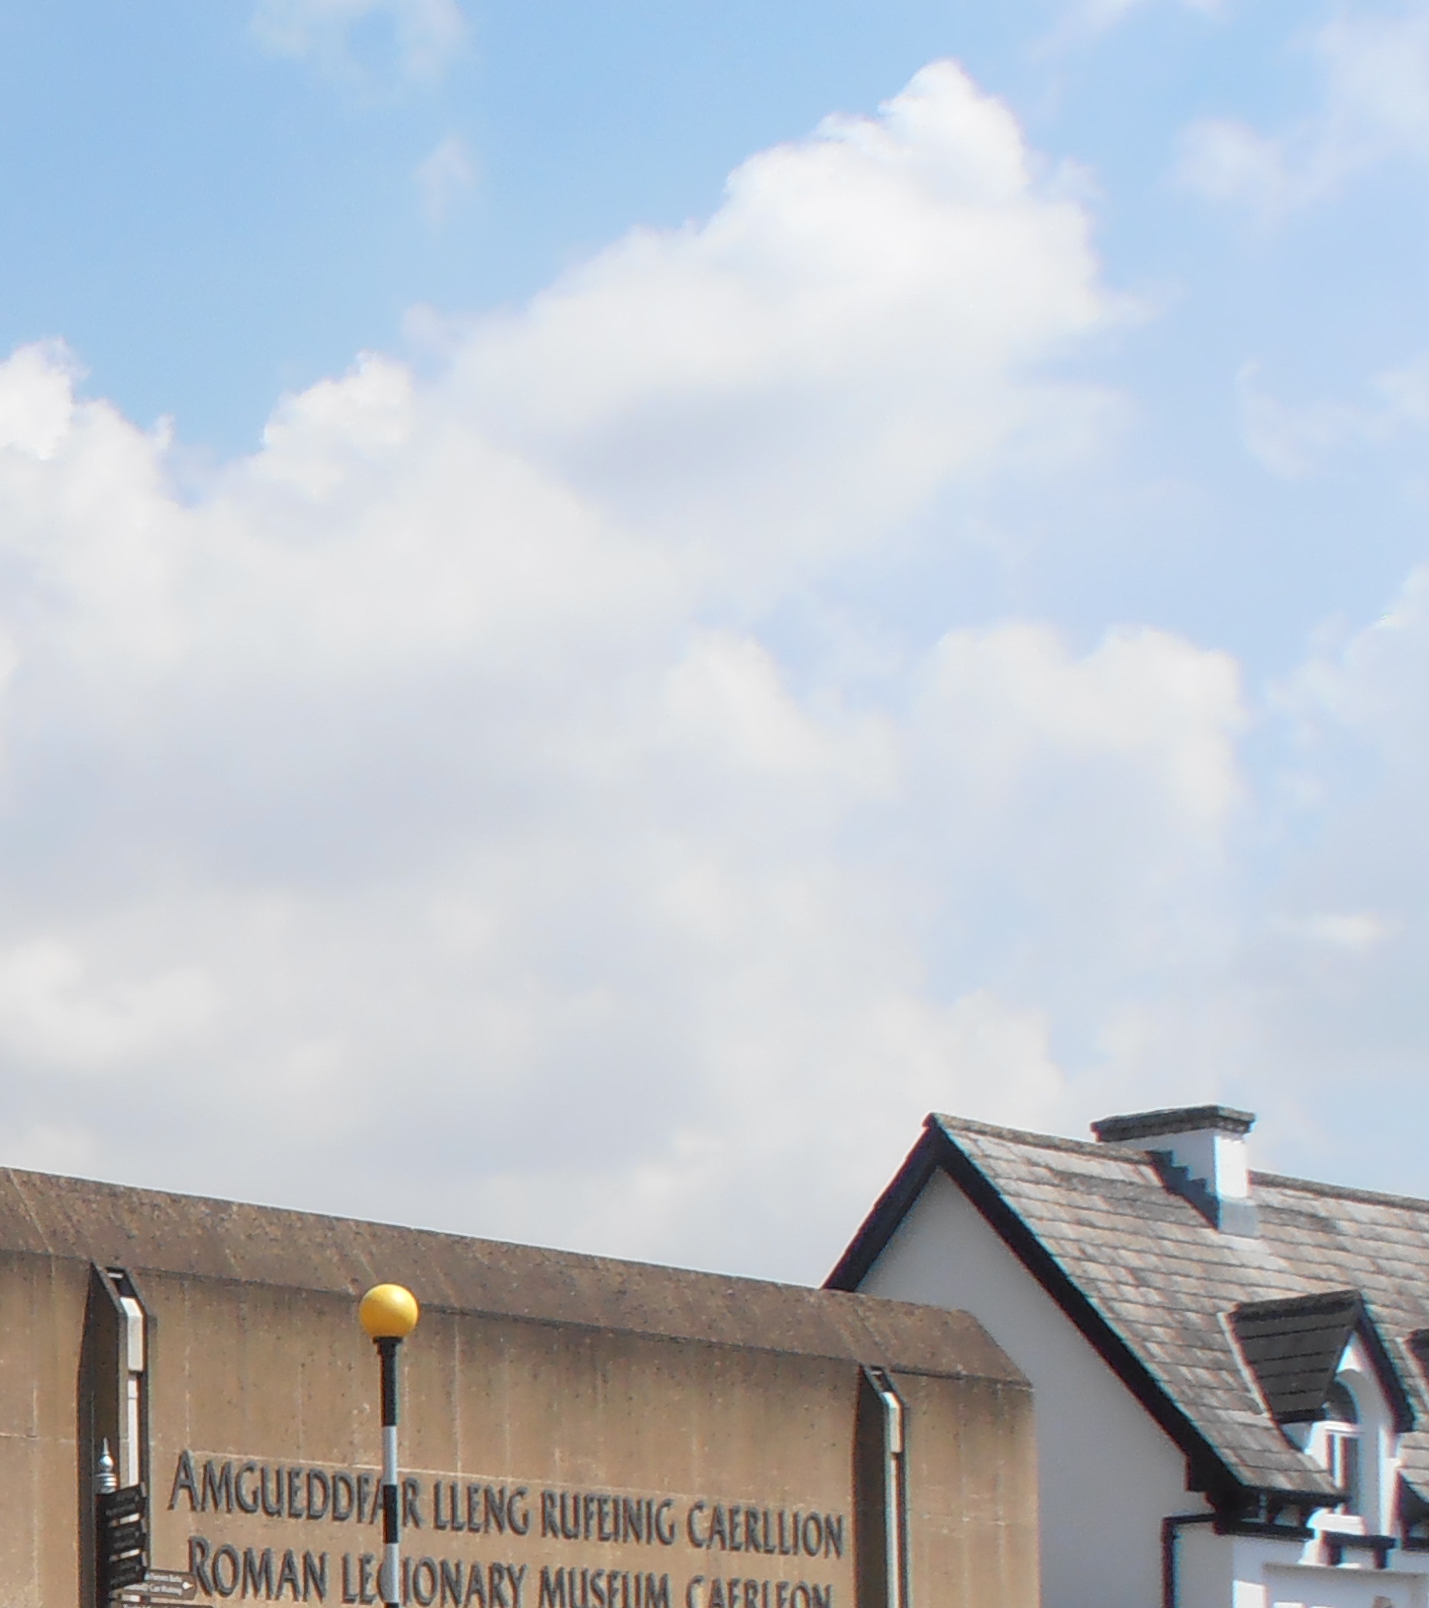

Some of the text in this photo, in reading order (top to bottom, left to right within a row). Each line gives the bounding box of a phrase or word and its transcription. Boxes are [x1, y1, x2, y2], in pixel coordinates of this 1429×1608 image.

[434, 1479, 530, 1536] LLENG
[541, 1488, 675, 1546] RUFEINIG
[687, 1500, 845, 1559] CAERLLION
[188, 1535, 327, 1604] ROMAN
